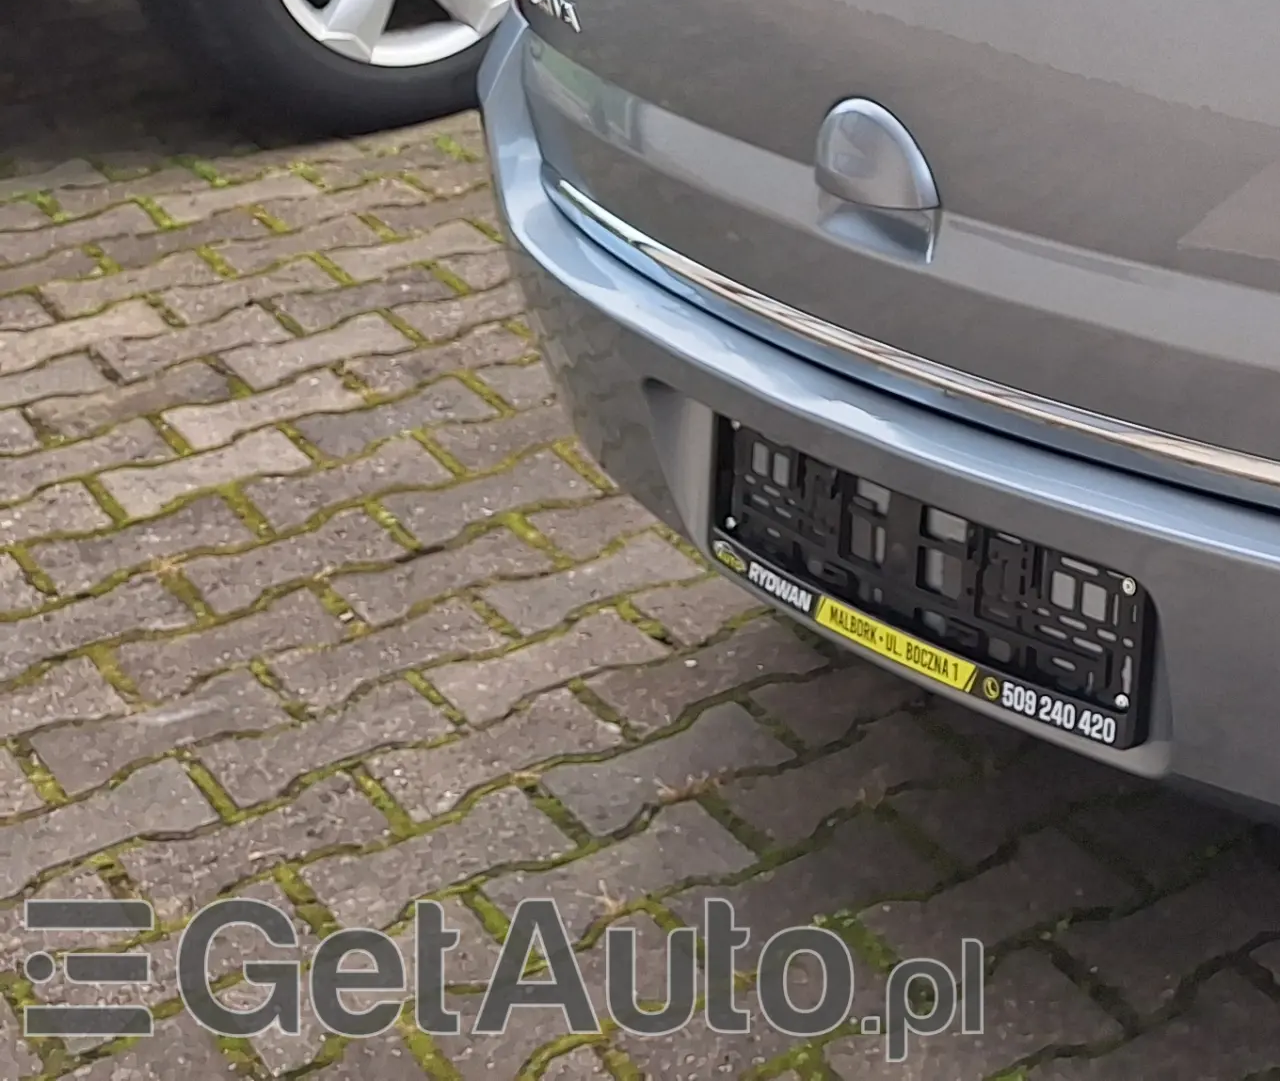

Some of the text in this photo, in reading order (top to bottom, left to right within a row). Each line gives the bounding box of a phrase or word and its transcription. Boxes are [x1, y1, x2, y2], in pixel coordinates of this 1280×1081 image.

[747, 560, 813, 613] RYDWAN
[829, 605, 959, 682] MALBORK UL. BOCZNA 1
[1001, 680, 1117, 744] 509 240 420
